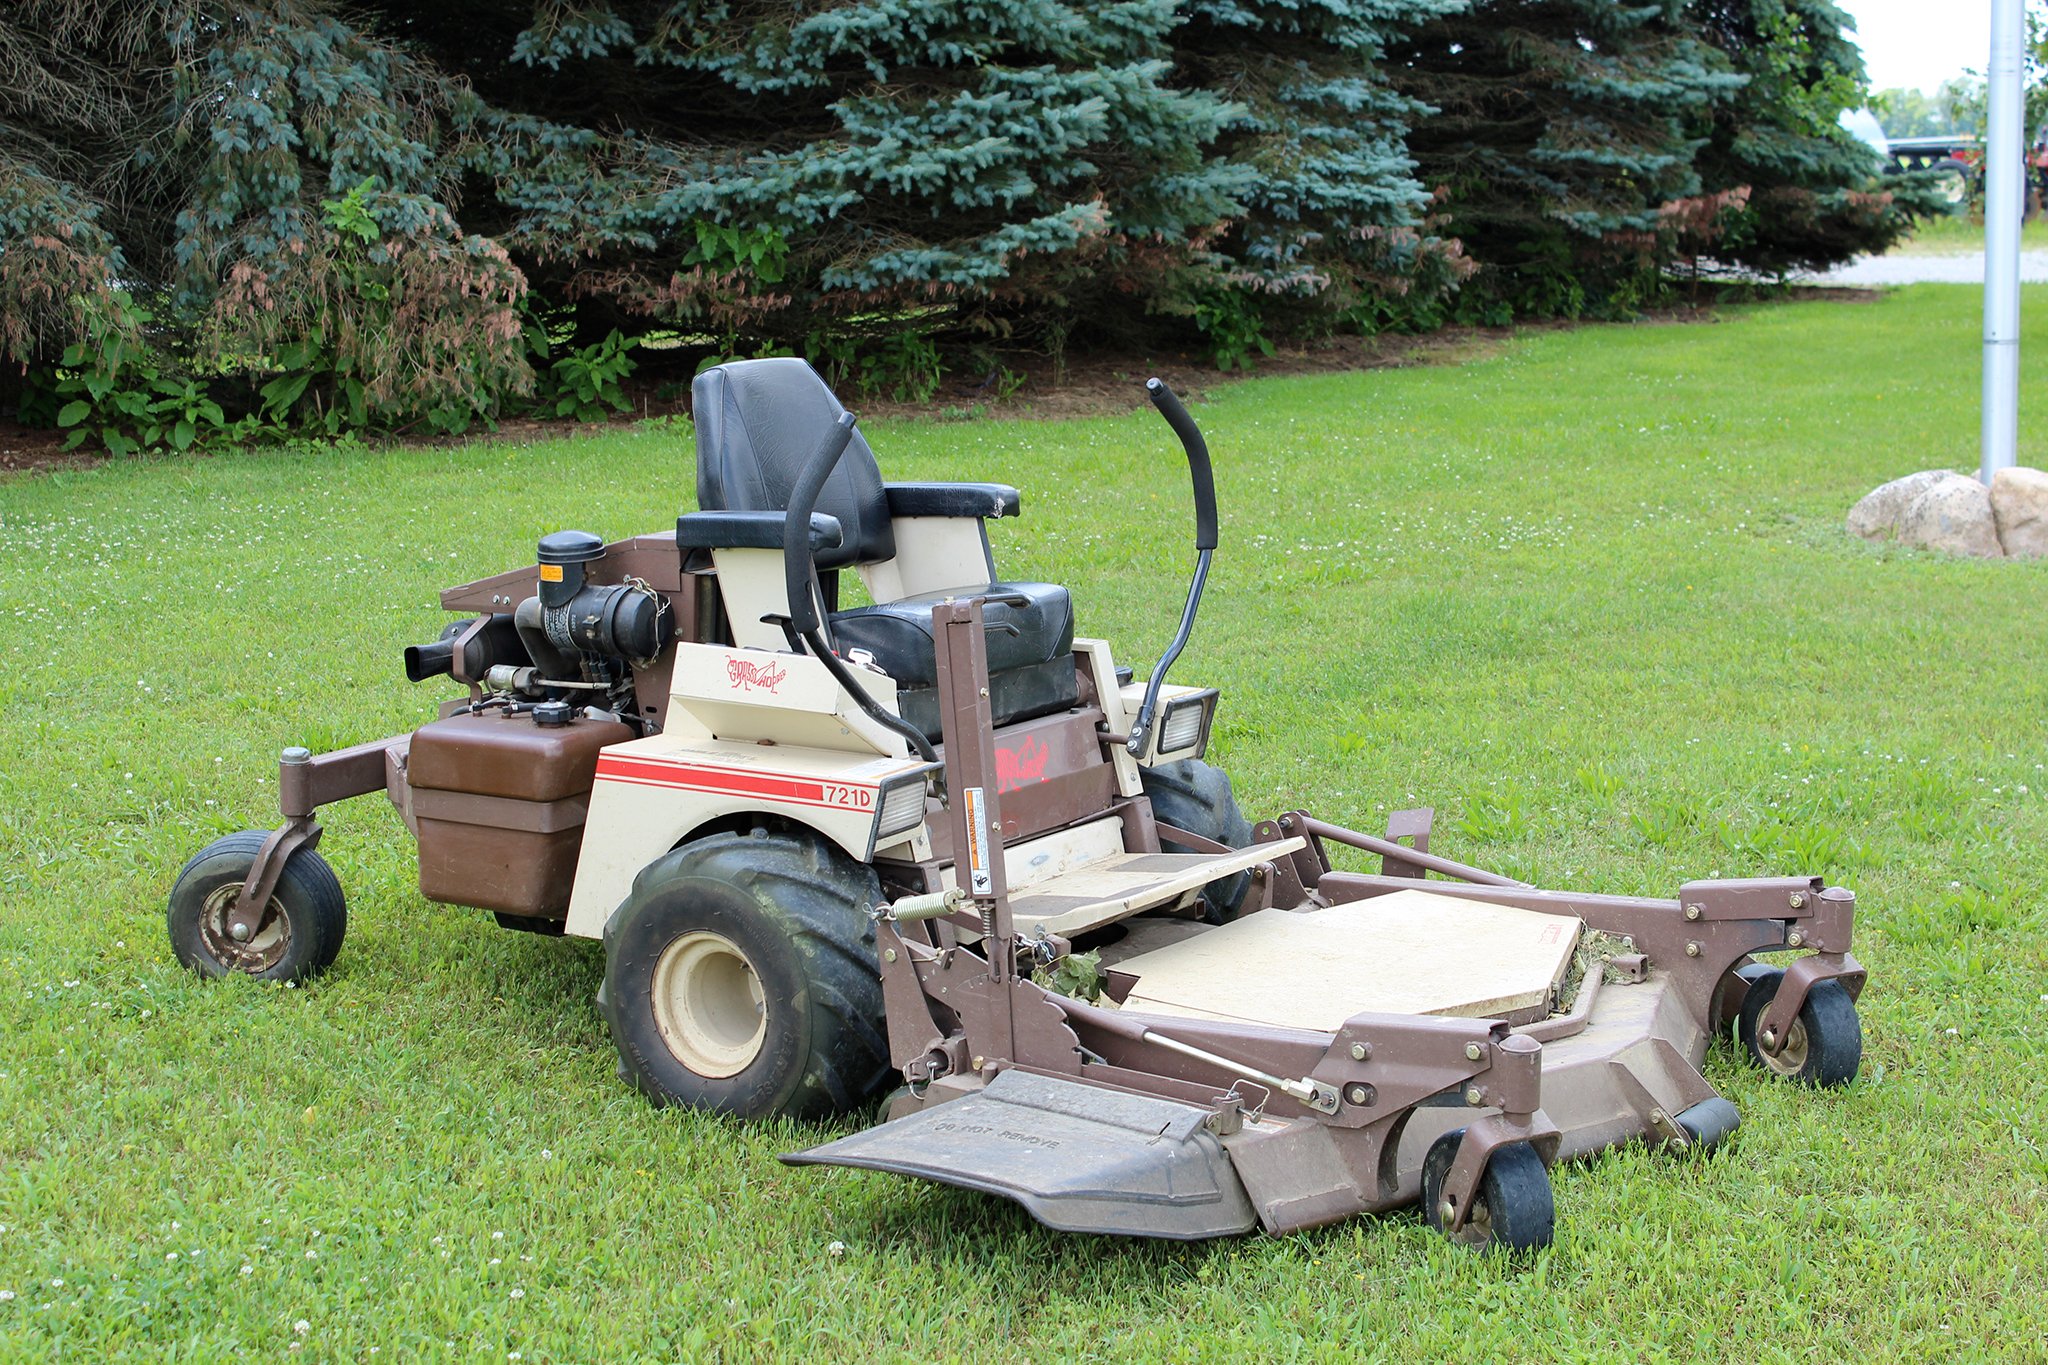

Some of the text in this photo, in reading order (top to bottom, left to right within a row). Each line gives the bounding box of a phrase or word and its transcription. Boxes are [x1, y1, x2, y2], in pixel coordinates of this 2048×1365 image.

[826, 786, 871, 807] 721D
[967, 808, 977, 845] WARNING
[934, 1122, 1061, 1149] DO NOT REMOVE
